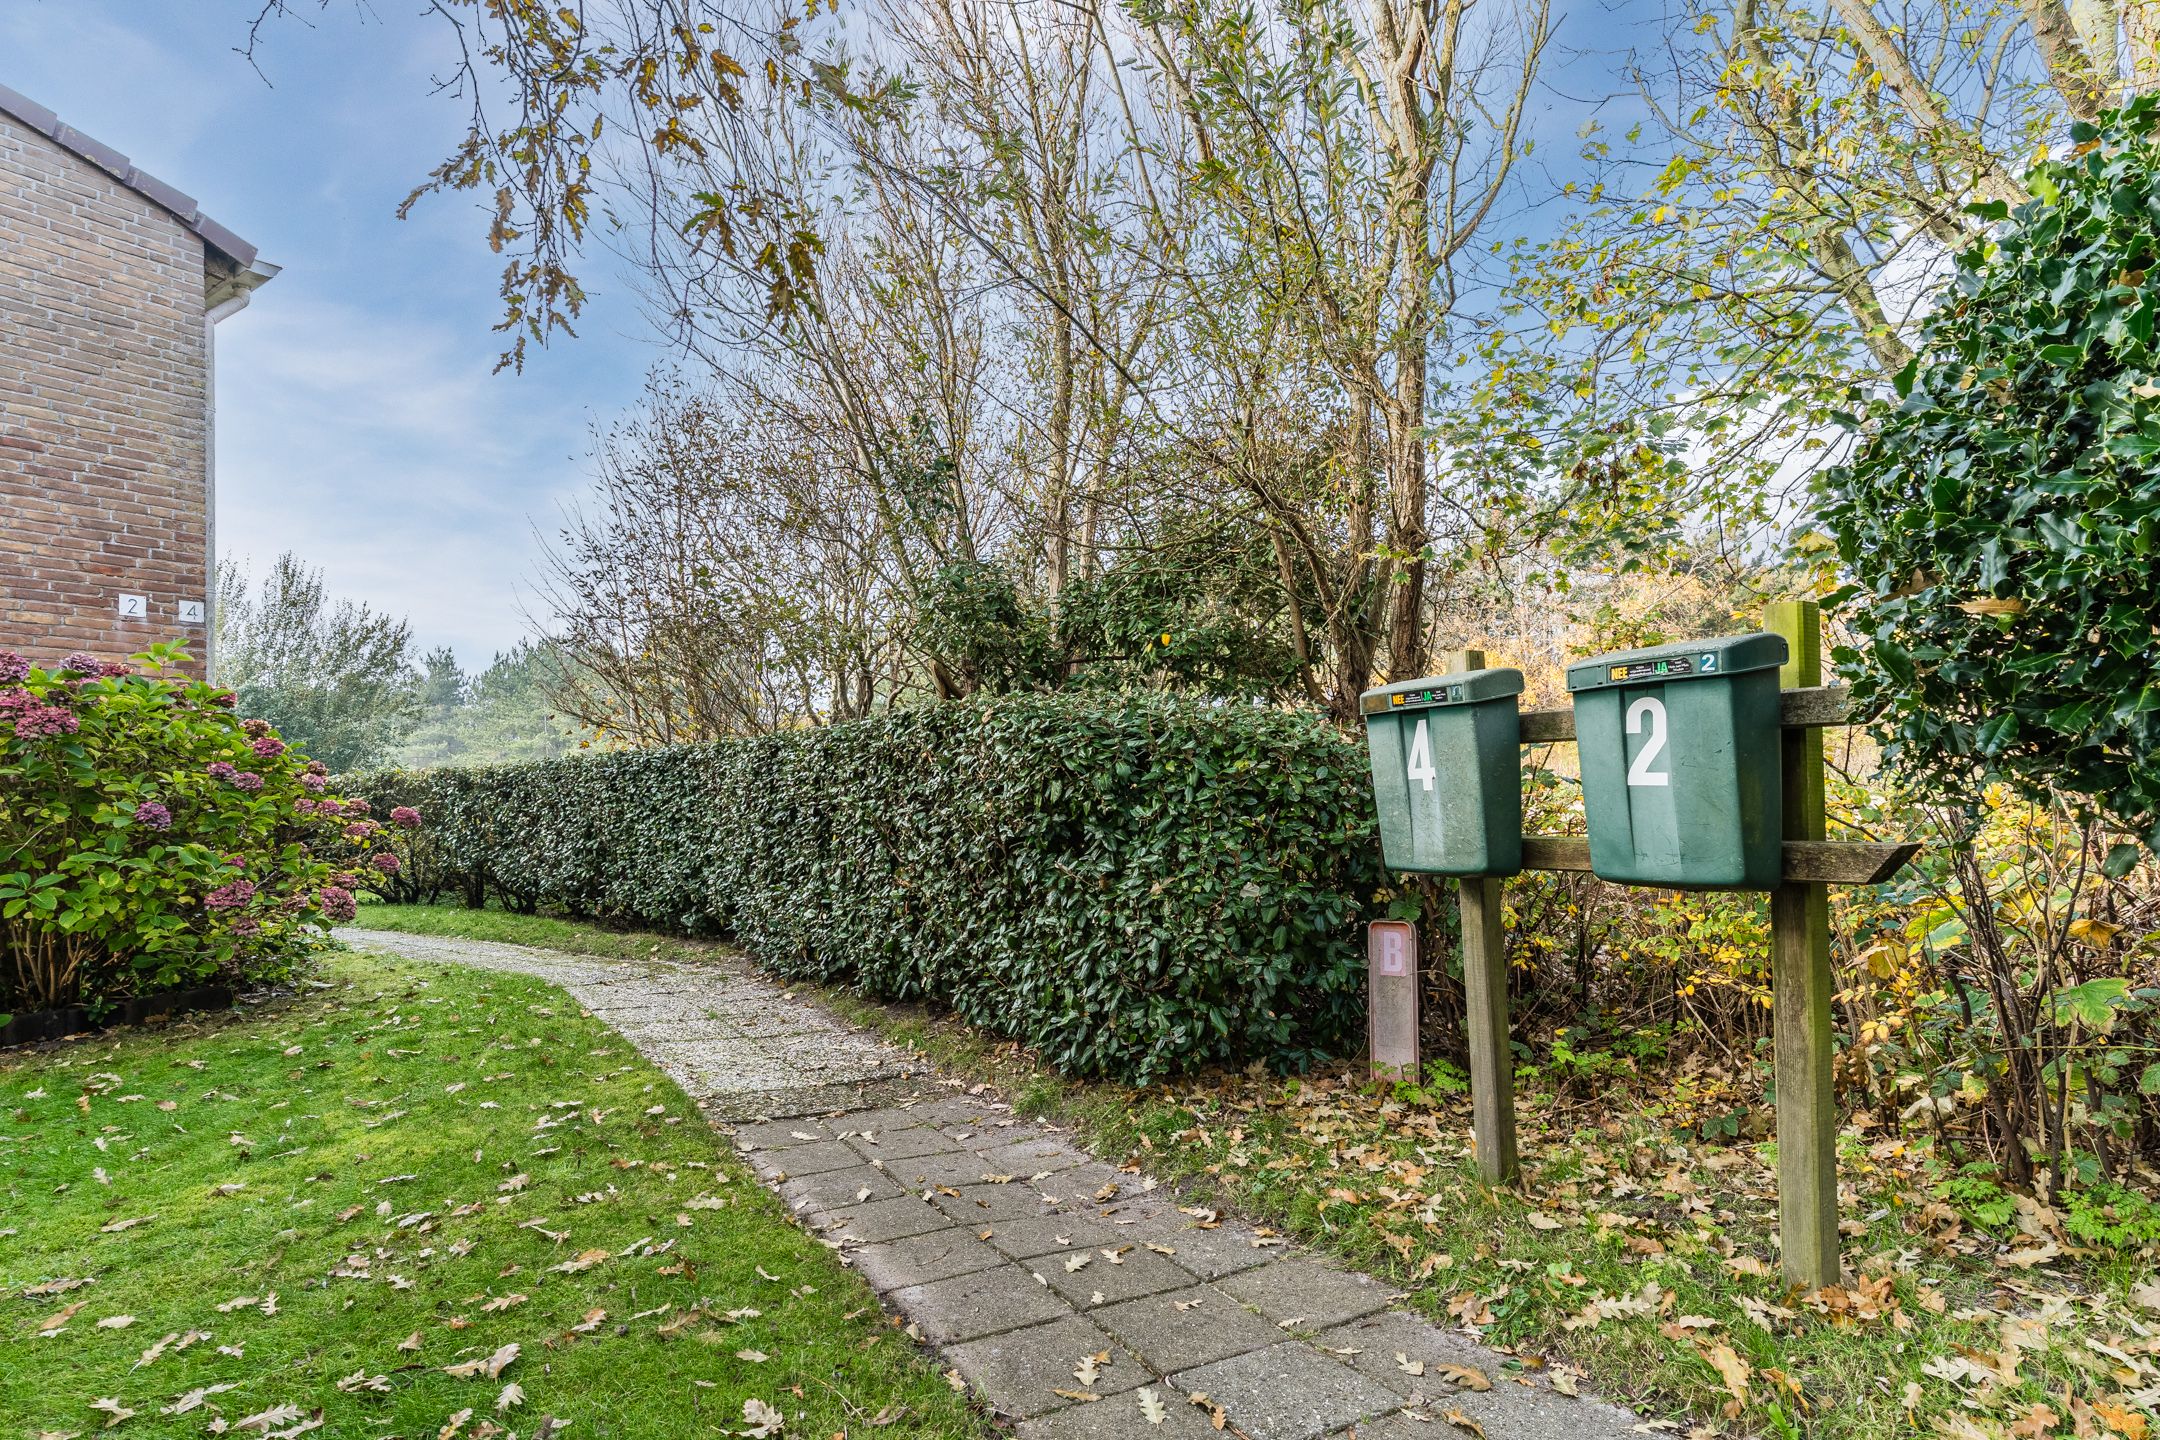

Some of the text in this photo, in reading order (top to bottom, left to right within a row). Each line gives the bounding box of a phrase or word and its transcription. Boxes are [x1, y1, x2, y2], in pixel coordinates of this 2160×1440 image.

[128, 598, 138, 614] 2
[187, 605, 198, 620] 4
[1655, 662, 1668, 674] JA
[1701, 654, 1715, 671] 2
[1611, 667, 1628, 680] NEE
[1392, 694, 1404, 706] NEE
[1423, 691, 1432, 701] JA
[1626, 697, 1668, 786] 2
[1408, 719, 1436, 791] 4
[1384, 932, 1402, 972] B
